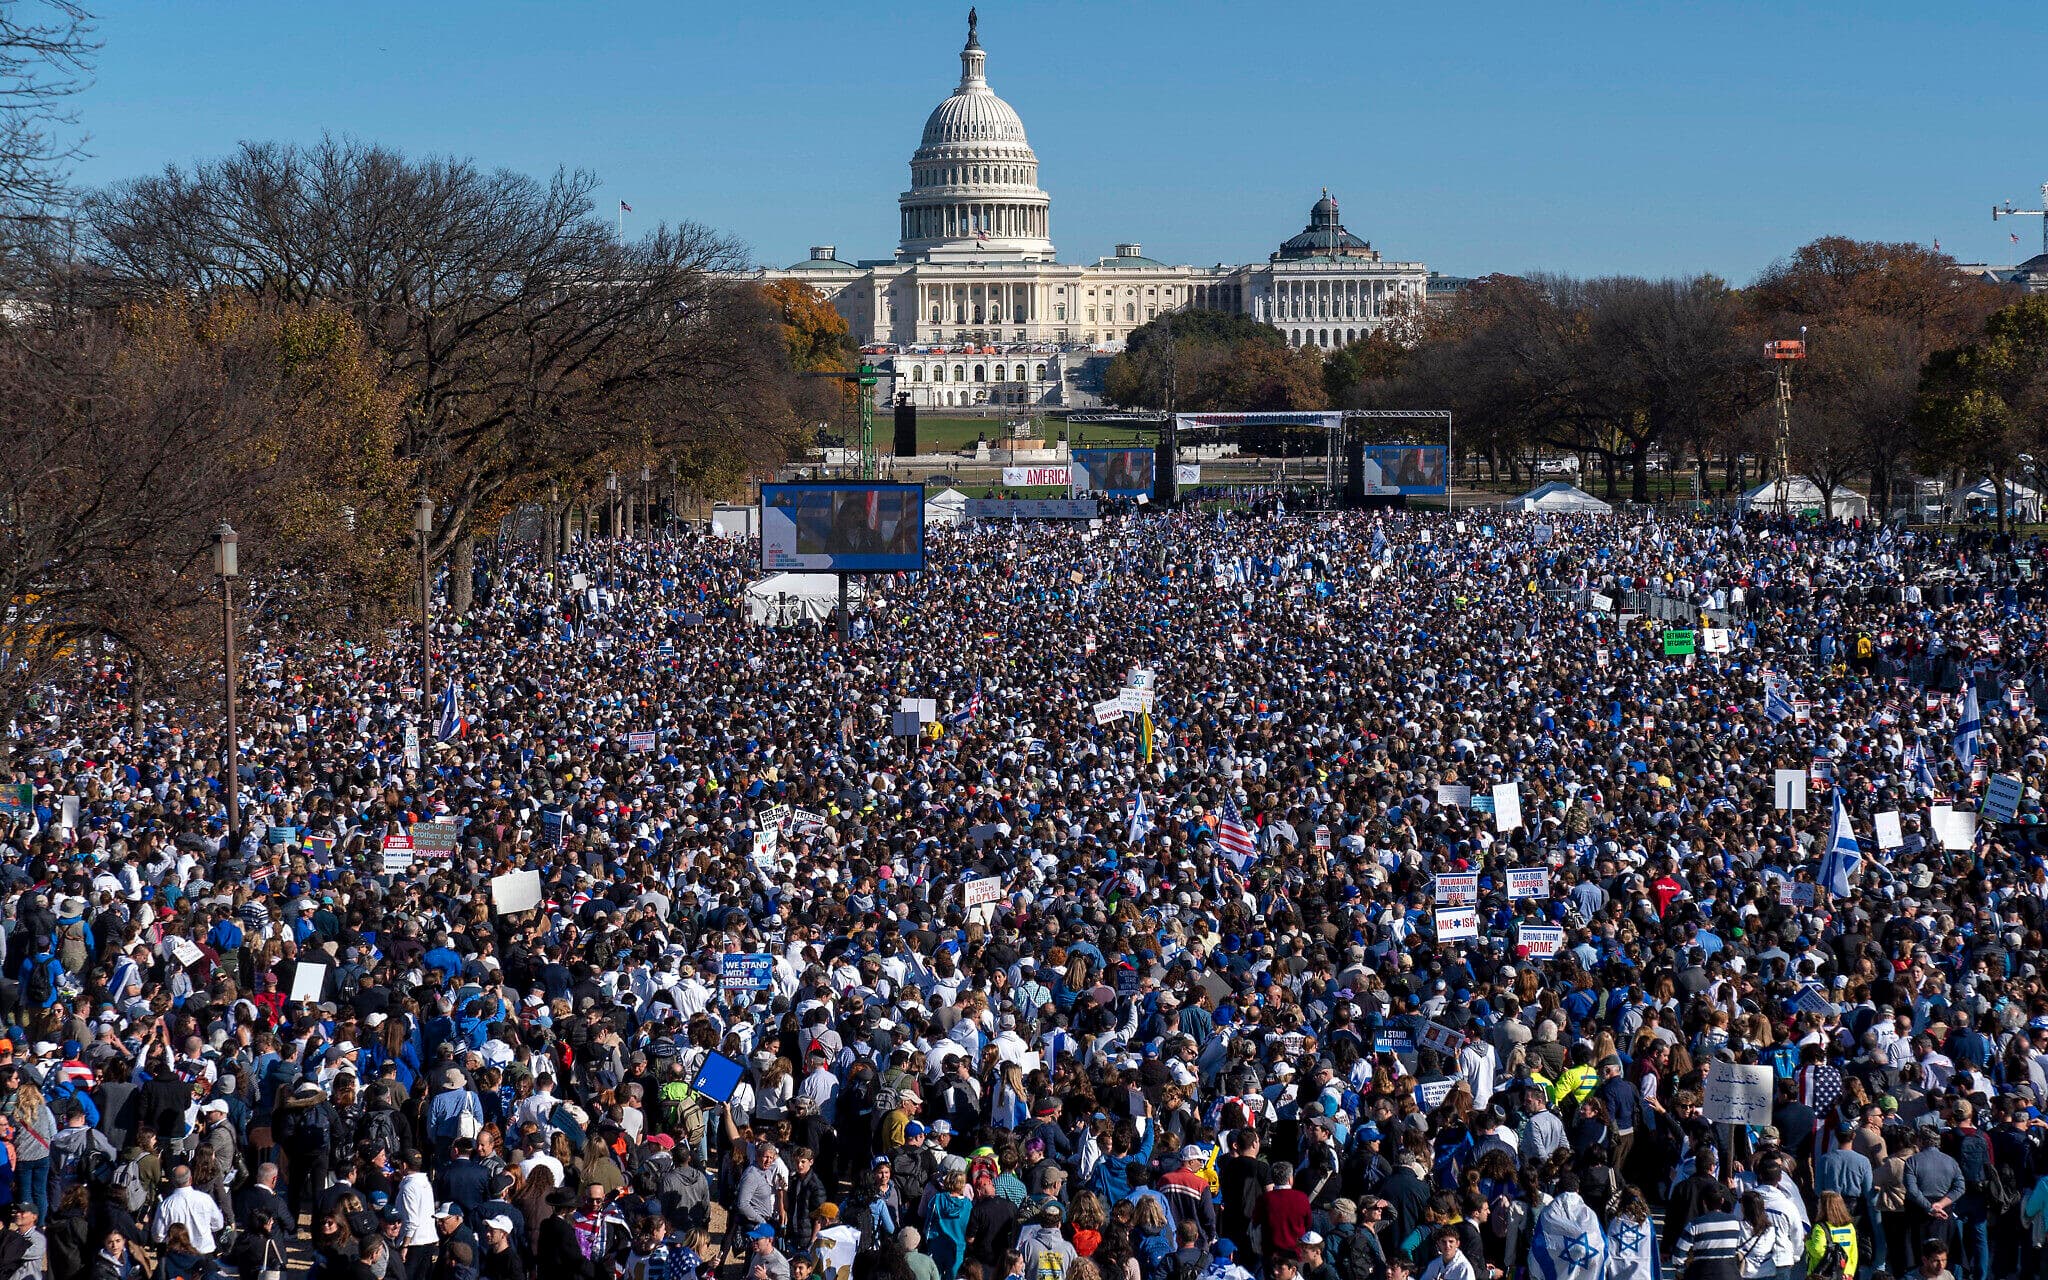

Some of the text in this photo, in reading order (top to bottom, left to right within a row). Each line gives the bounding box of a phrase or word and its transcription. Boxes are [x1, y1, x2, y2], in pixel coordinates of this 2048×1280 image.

[1195, 414, 1324, 426] AMERICANS MARCH FOR ISRAEL
[968, 881, 988, 889] BRING
[1512, 880, 1543, 888] CAMPUSES
[969, 891, 997, 904] HOME
[1438, 919, 1453, 930] MKE
[1543, 933, 1558, 941] THEM
[1528, 942, 1553, 953] HOME
[726, 978, 760, 986] ISRAEL
